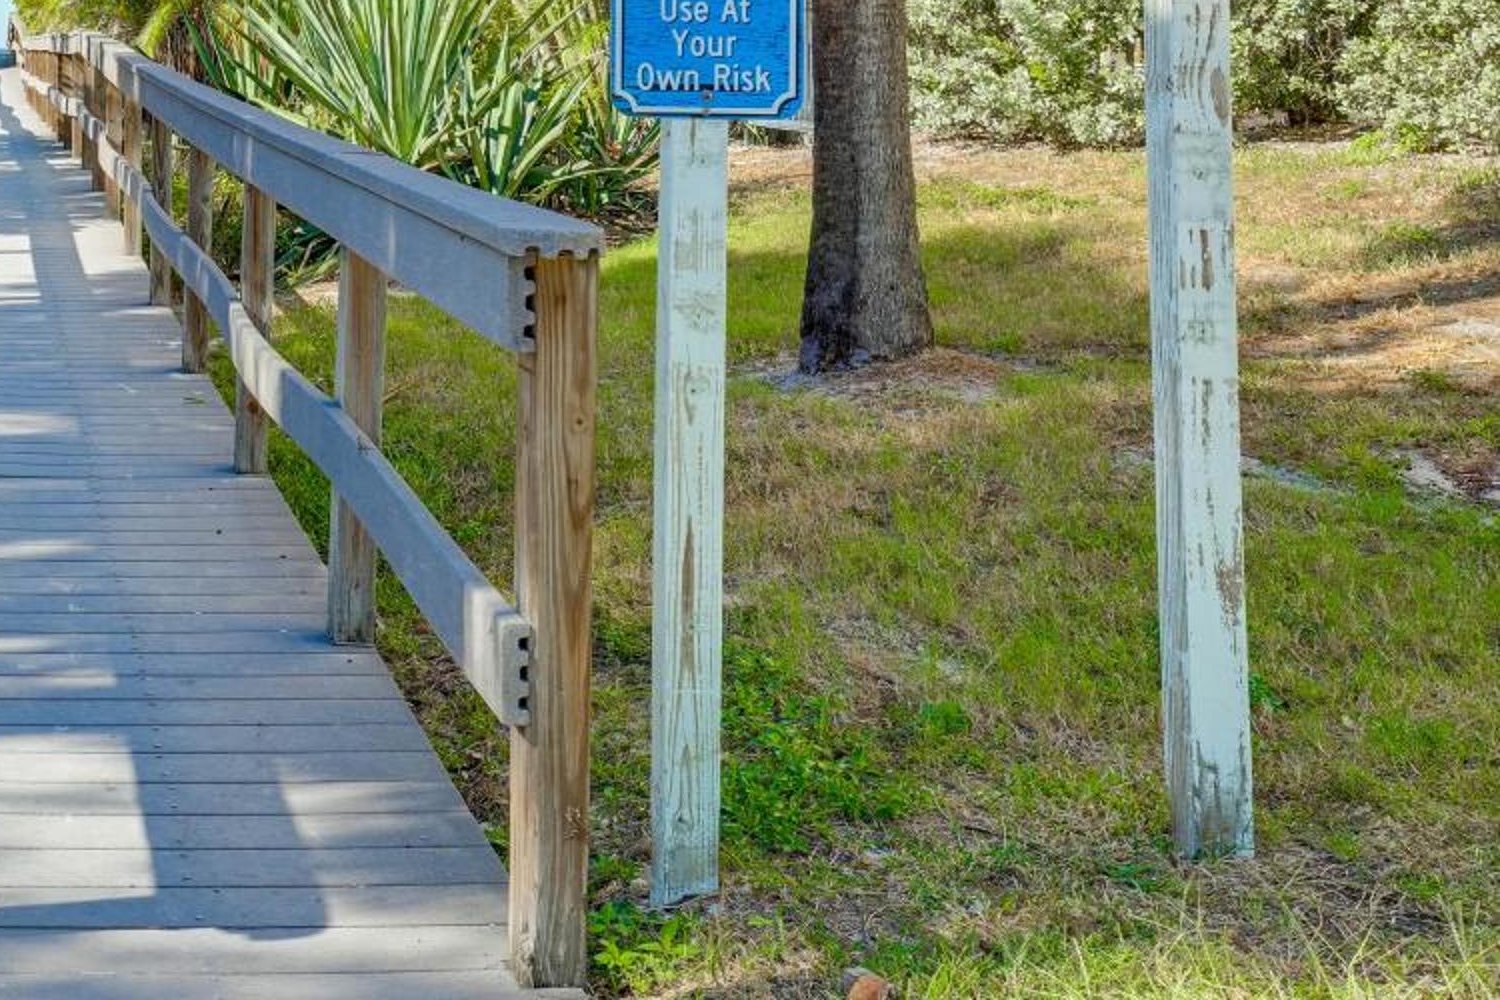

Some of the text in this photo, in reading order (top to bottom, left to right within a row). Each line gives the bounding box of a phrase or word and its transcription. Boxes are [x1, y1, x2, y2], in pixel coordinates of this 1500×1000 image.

[671, 29, 737, 57] Your
[636, 63, 772, 92] Own Risk
